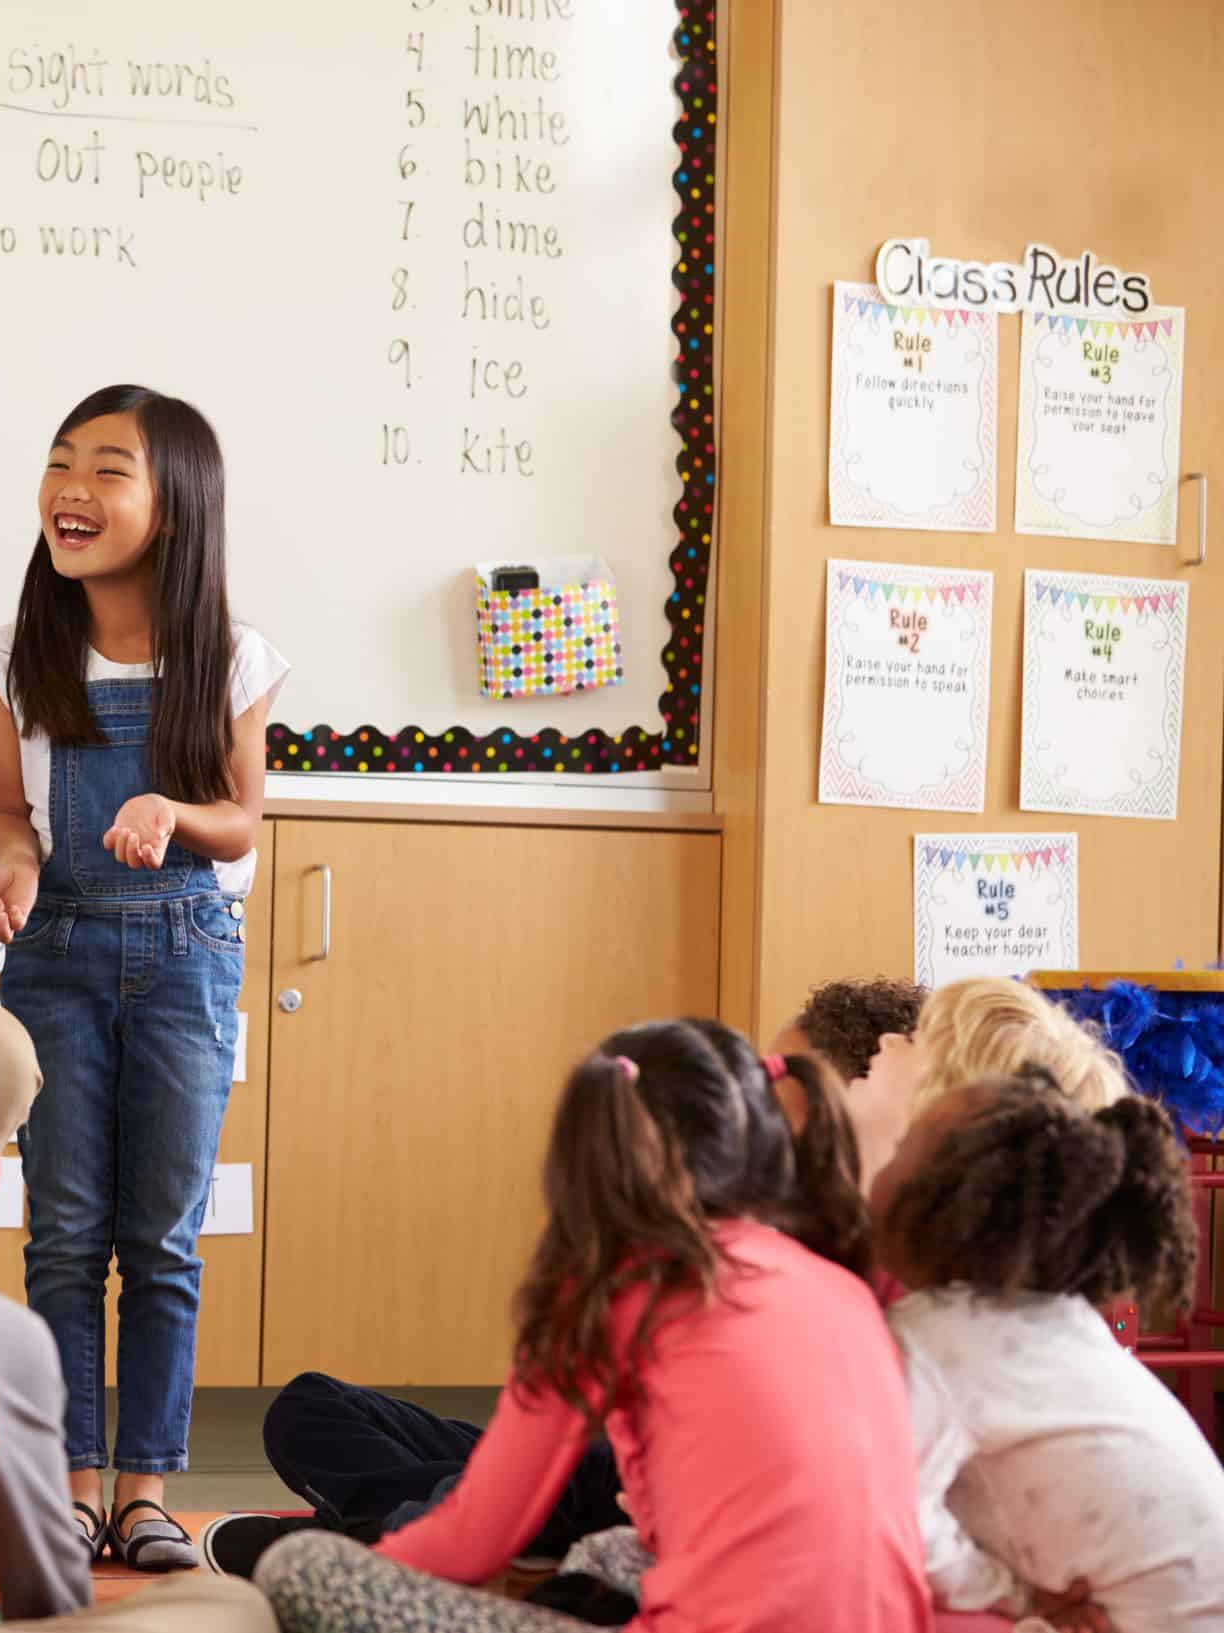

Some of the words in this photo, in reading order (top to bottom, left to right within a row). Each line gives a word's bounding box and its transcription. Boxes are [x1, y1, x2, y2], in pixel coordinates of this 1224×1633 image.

[464, 25, 560, 81] time
[128, 58, 235, 107] words
[463, 94, 570, 145] white
[136, 150, 243, 203] people
[464, 137, 556, 194] bike
[463, 201, 563, 259] dime
[40, 225, 137, 268] work
[883, 243, 1017, 305] Class
[1028, 247, 1149, 313] Rules
[461, 259, 550, 330] hide
[893, 330, 931, 352] Rule
[1083, 341, 1119, 363] Rule
[470, 344, 528, 399] ice
[856, 374, 895, 390] Follow
[901, 377, 968, 393] directions
[888, 395, 934, 413] quickly
[1044, 386, 1075, 401] Raise
[1080, 391, 1102, 405] your
[1108, 392, 1135, 407] hand
[1044, 404, 1102, 418] permission
[1107, 408, 1119, 420] to
[1123, 409, 1155, 423] leave
[1072, 421, 1095, 434] your
[1101, 423, 1127, 435] seat
[889, 608, 927, 631] Rule
[1085, 619, 1121, 642] Rule
[846, 655, 881, 670] Raise
[887, 661, 912, 675] your
[917, 660, 945, 675] hand
[846, 674, 909, 689] permission
[915, 677, 927, 689] to
[933, 680, 968, 694] speak
[1064, 668, 1096, 683] Make
[1102, 672, 1138, 686] smart
[1076, 687, 1124, 701] choices
[977, 879, 1015, 899] Rule
[945, 925, 979, 941] Keep
[984, 927, 1012, 942] your
[1018, 925, 1048, 938] dear
[944, 942, 997, 957] teacher
[1003, 940, 1050, 959] happy!
